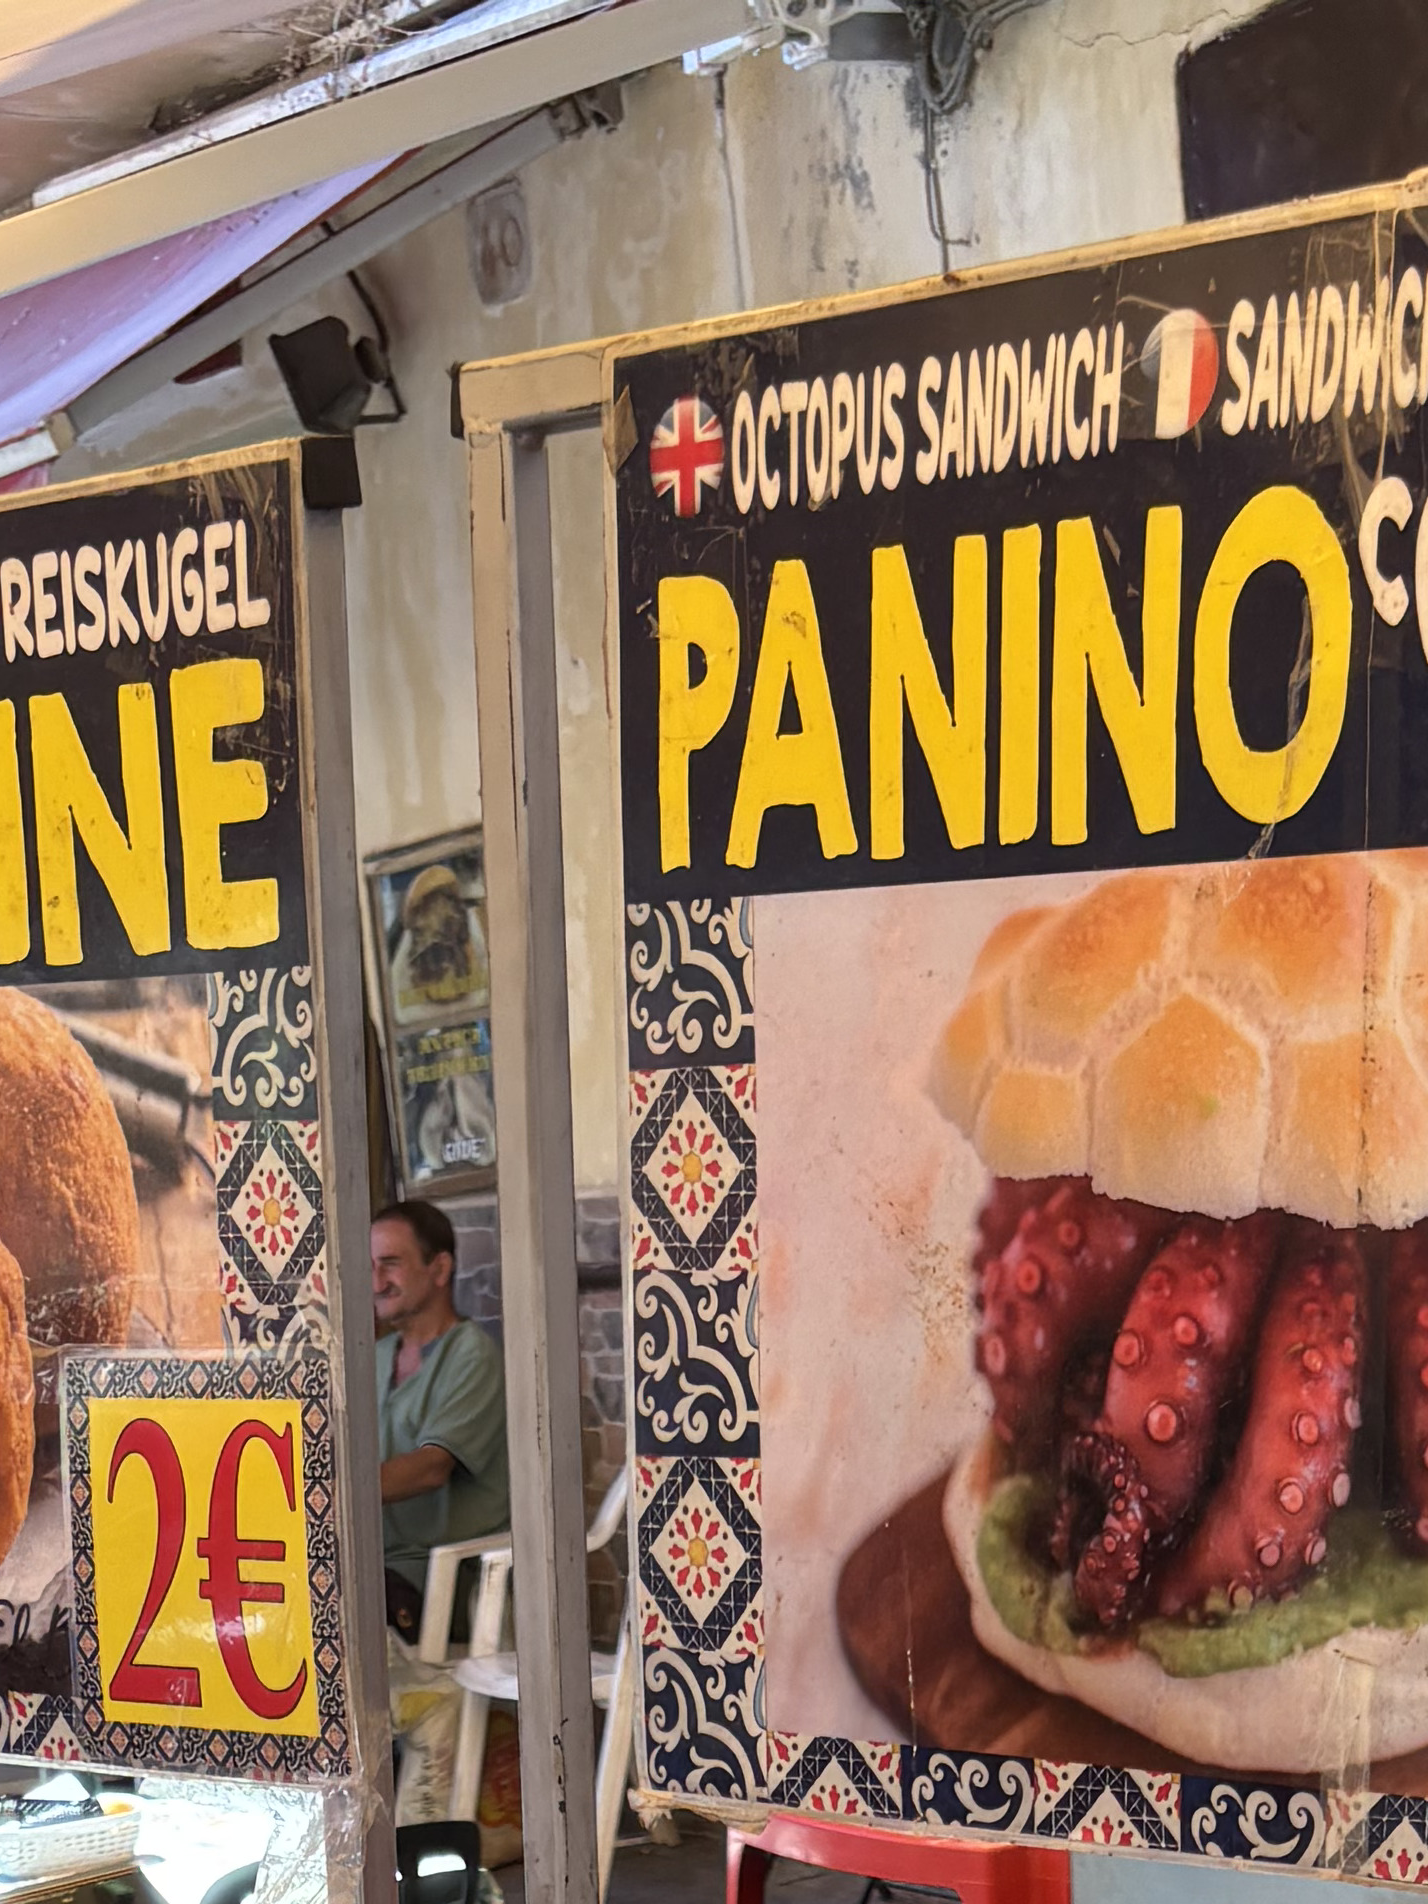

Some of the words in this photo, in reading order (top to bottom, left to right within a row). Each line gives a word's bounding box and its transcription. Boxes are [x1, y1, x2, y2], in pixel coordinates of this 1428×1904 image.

[731, 362, 906, 515] OCTOPUS
[914, 320, 1125, 486] SANDWICH
[0, 520, 271, 664] REISKUGEL
[656, 482, 1354, 874] PANINO
[107, 1418, 308, 1719] 2€
